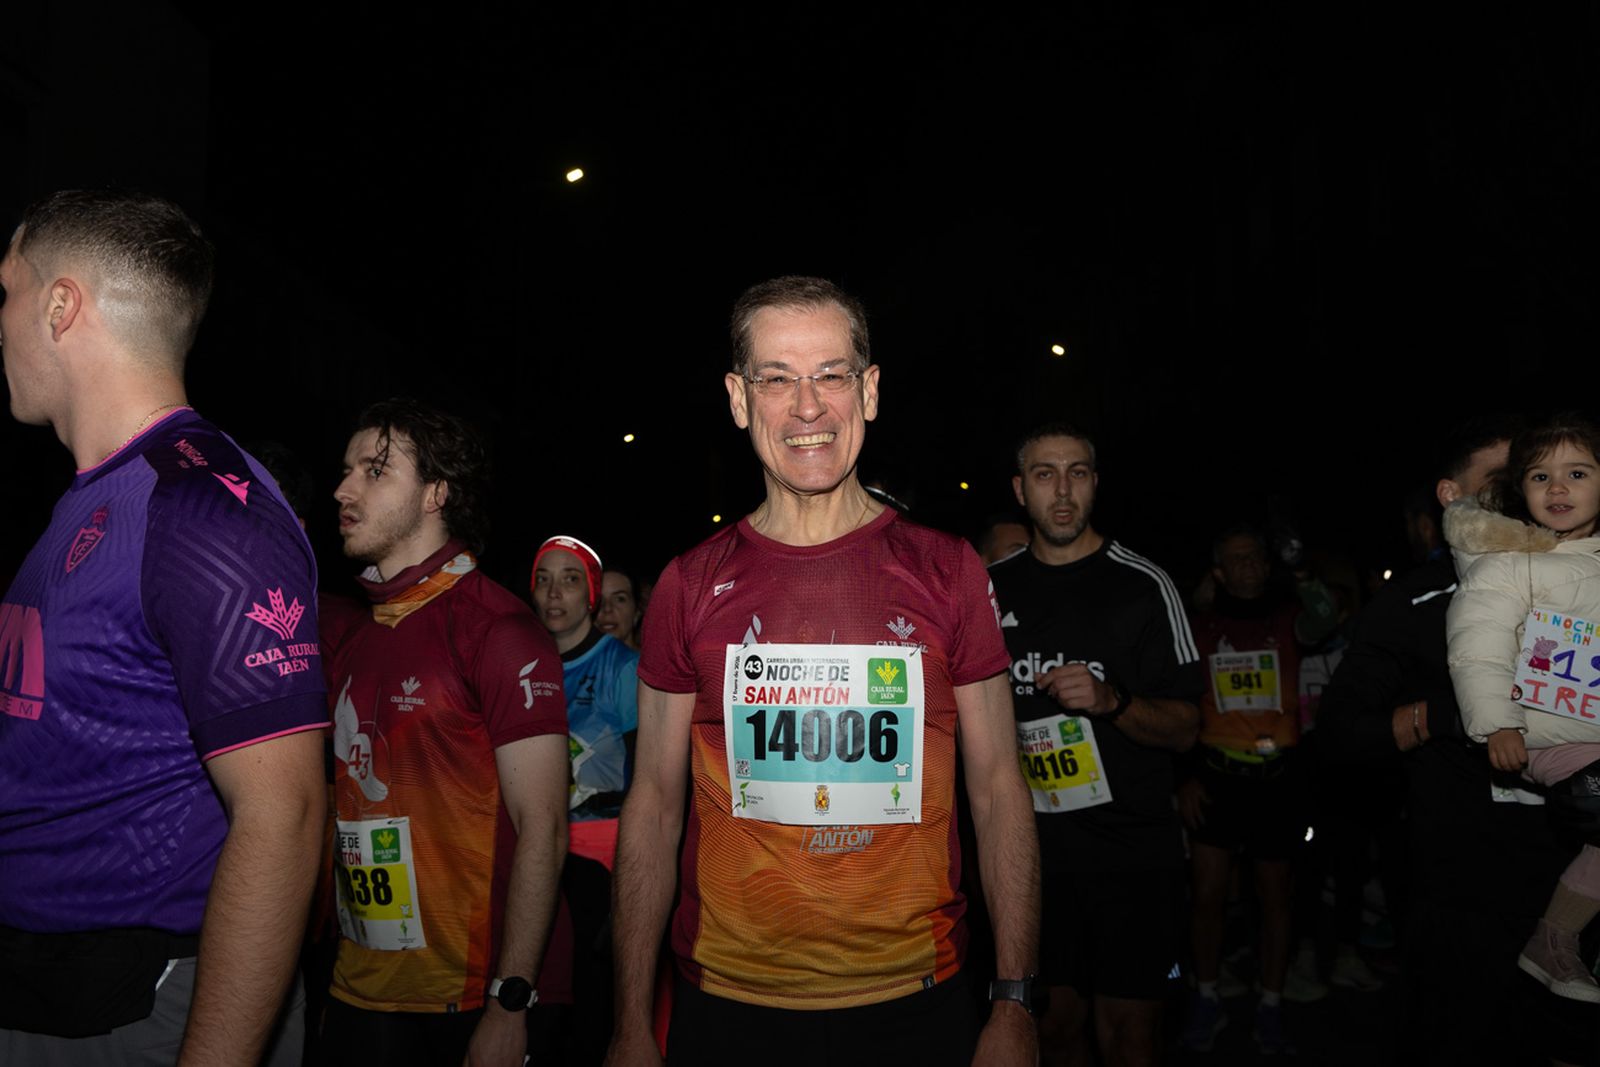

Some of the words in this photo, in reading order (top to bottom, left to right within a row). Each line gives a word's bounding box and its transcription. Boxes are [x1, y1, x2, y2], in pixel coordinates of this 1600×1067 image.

[244, 647, 286, 668] CAJA
[286, 643, 321, 657] RURAL
[277, 658, 310, 677] JAÉN
[745, 660, 762, 673] 43
[766, 665, 824, 682] NOCHE
[828, 665, 850, 682] DE
[1008, 652, 1105, 683] dids
[1231, 671, 1262, 690] 941
[745, 686, 781, 704] SAN
[785, 682, 850, 705] ANTÓN
[746, 709, 899, 763] 14006
[1039, 728, 1051, 739] DE
[349, 745, 370, 780] 43
[348, 836, 360, 849] DE
